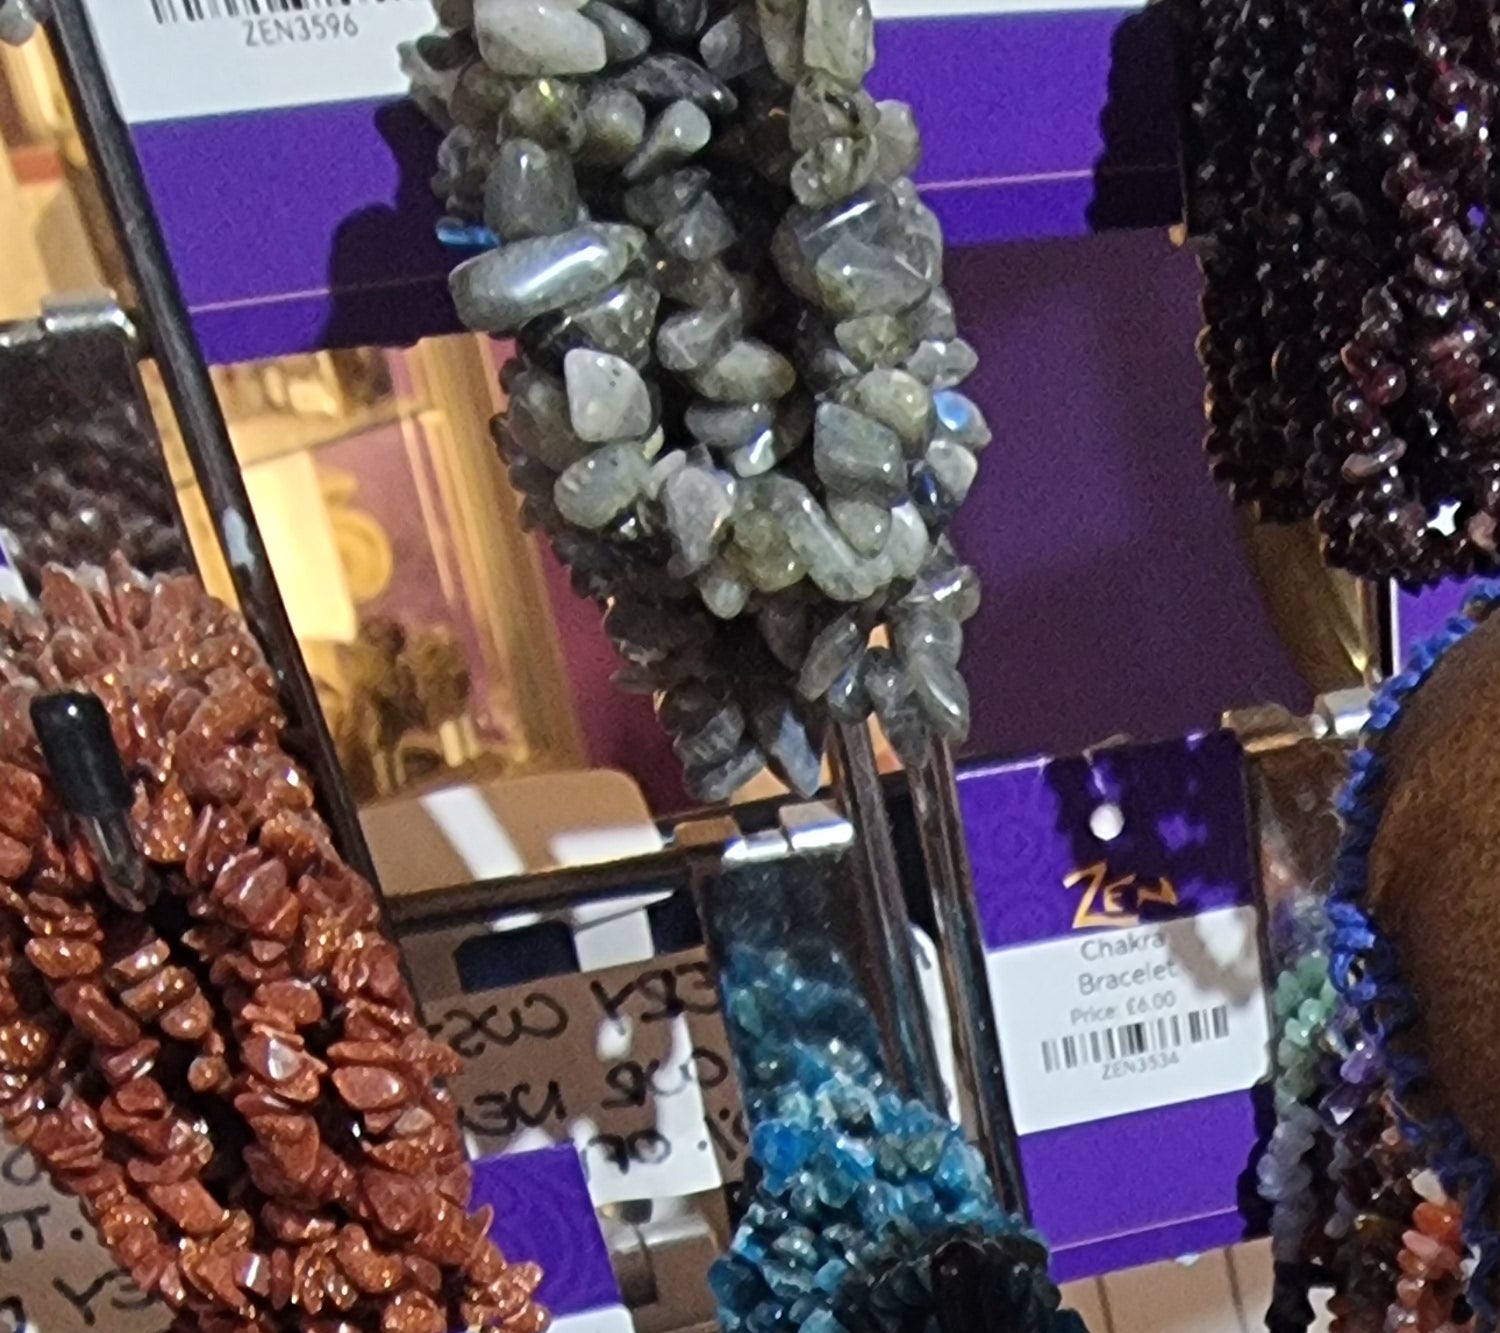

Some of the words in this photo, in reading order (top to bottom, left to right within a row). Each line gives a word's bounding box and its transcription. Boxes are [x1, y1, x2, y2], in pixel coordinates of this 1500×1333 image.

[242, 13, 358, 47] ZEN3596
[1063, 860, 1178, 928] ZEN
[1081, 931, 1166, 961] Chakra
[1078, 960, 1178, 996] Bracelet
